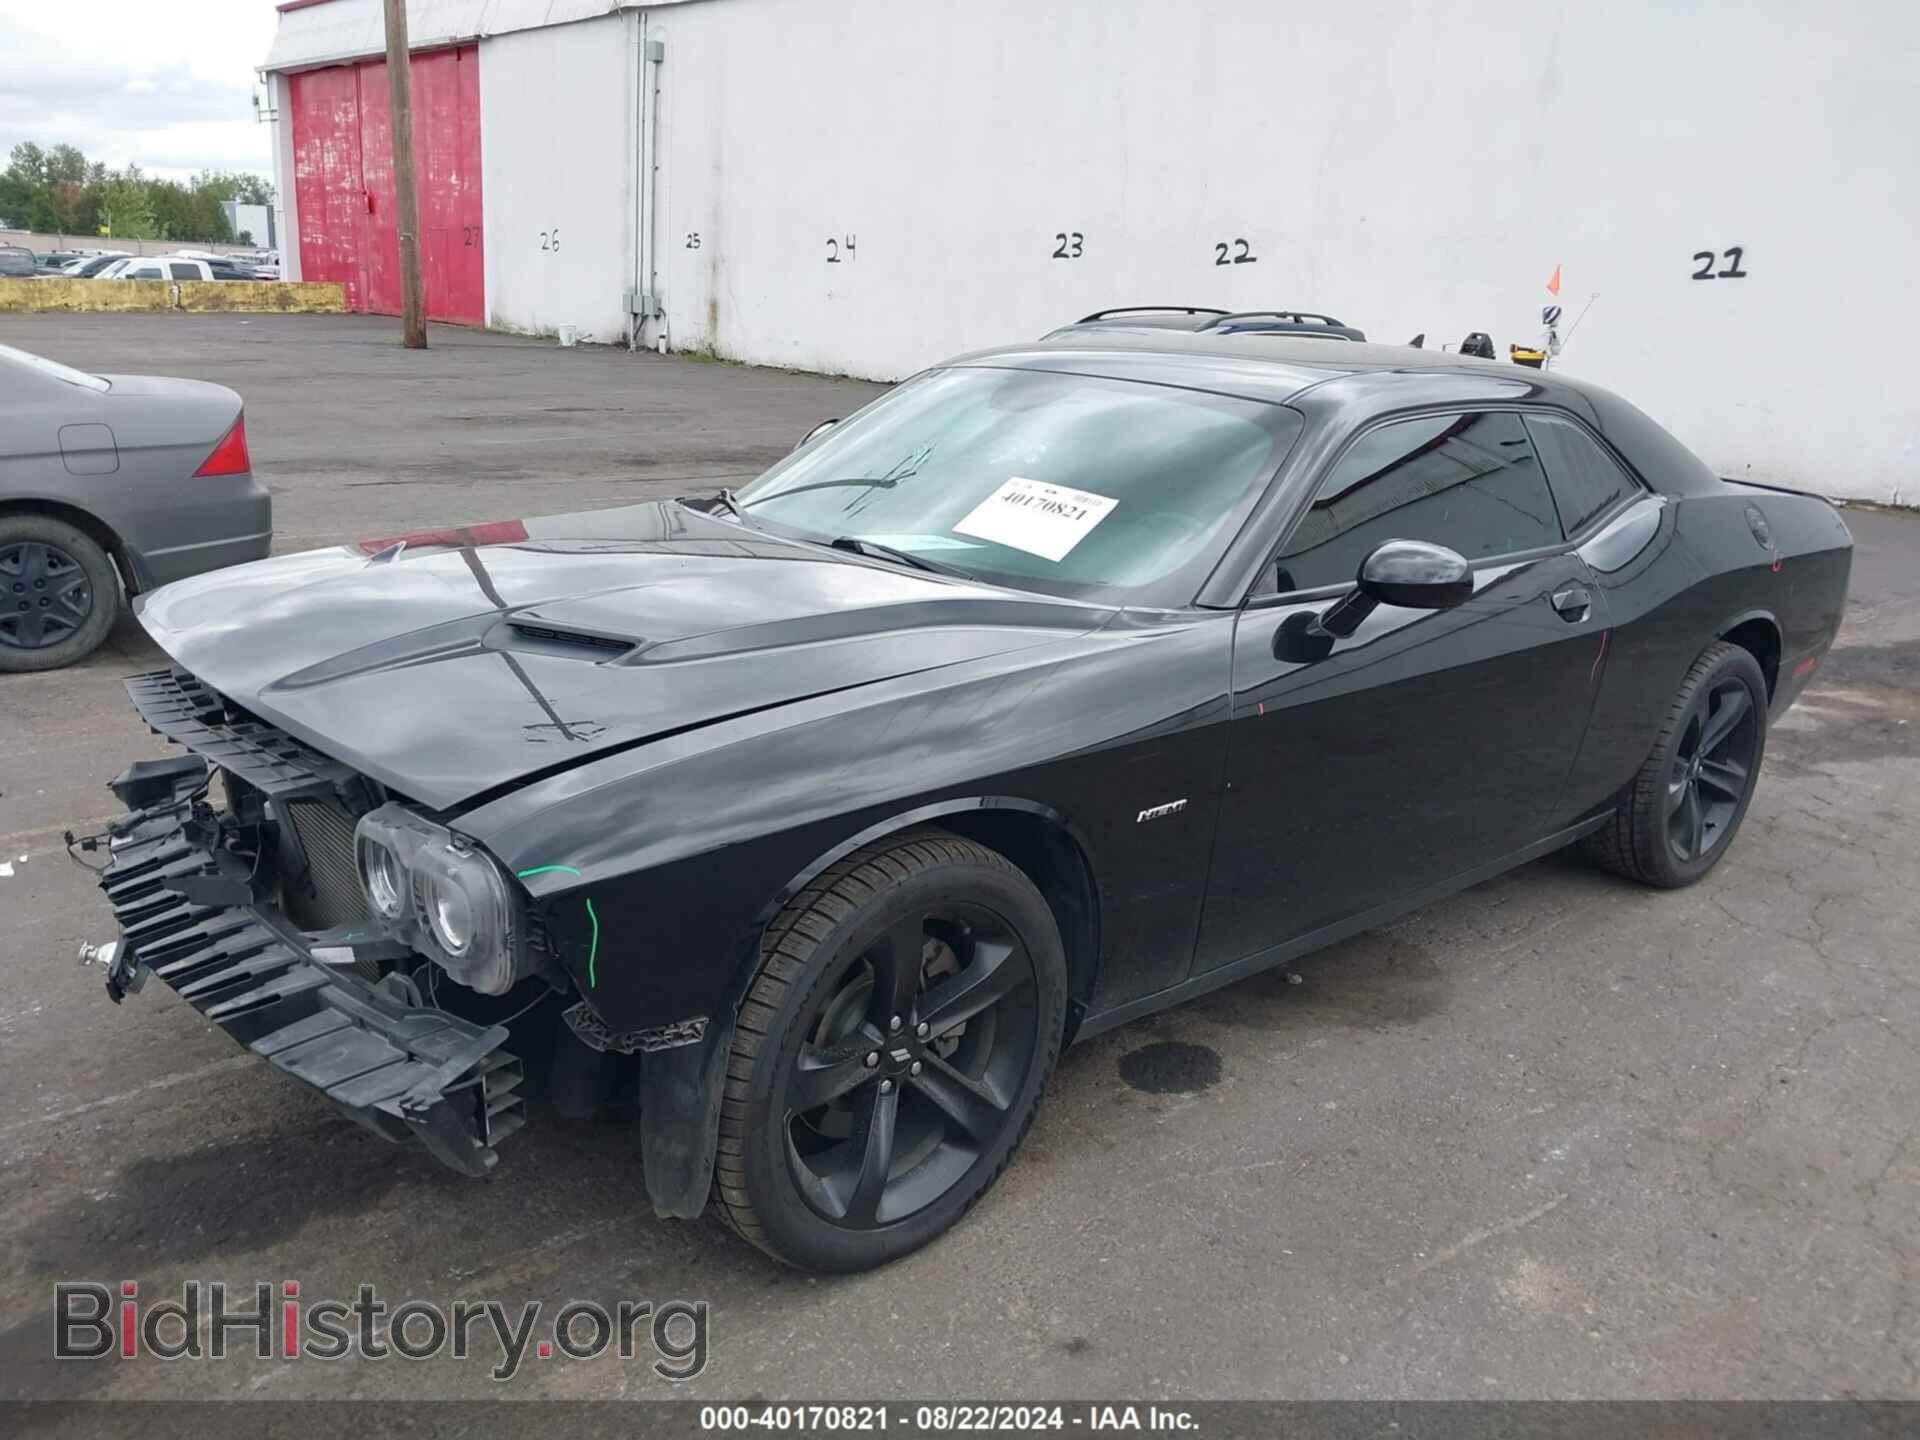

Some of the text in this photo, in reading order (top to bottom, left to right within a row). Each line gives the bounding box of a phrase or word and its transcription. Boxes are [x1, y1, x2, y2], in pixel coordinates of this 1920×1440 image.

[464, 226, 481, 248] 27
[540, 228, 560, 252] 26
[686, 233, 701, 249] 25
[826, 234, 856, 263] 24
[1052, 232, 1084, 259] 23
[1215, 238, 1257, 266] 22
[1692, 246, 1746, 280] 21
